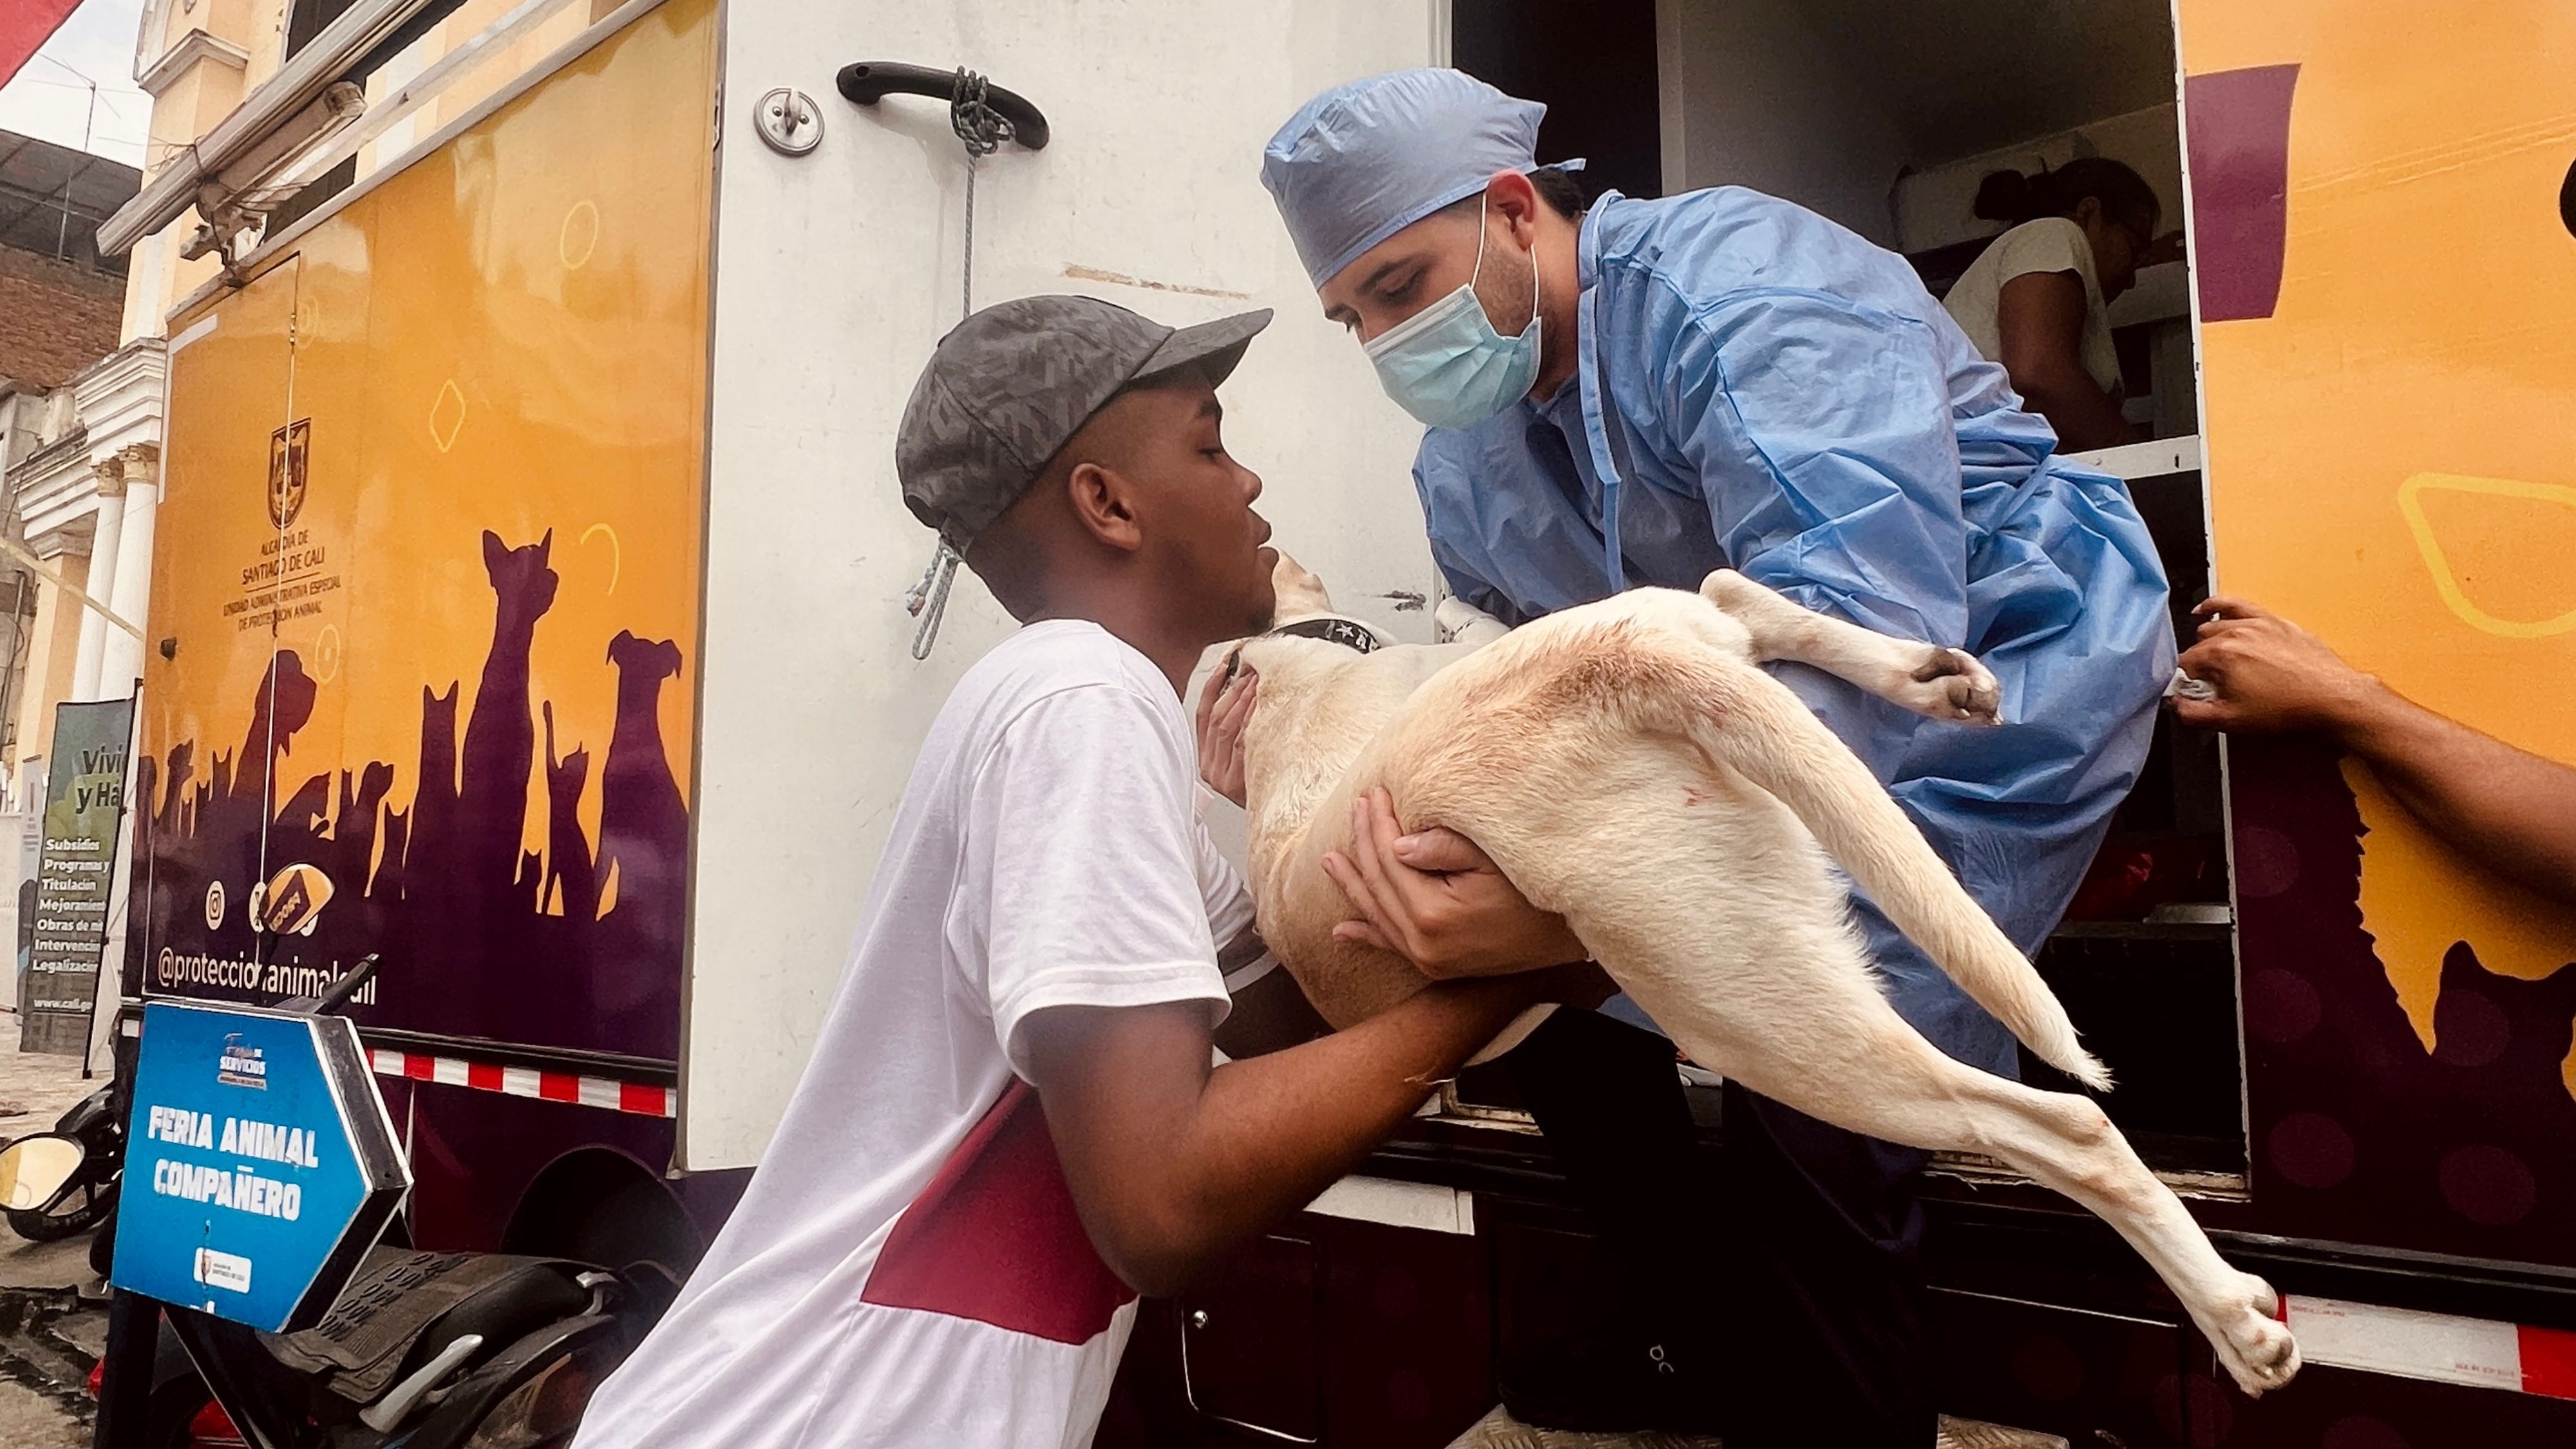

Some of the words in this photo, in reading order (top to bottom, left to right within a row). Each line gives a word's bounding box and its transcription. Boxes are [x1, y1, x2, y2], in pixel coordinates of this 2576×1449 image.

[261, 531, 295, 556] ALCADÍA
[298, 530, 308, 545] DE
[242, 558, 286, 585] SANTIAGO
[290, 554, 303, 571] DE
[305, 547, 325, 567] CALI
[76, 788, 93, 814] y
[46, 837, 101, 851] Subsidios
[44, 858, 102, 874] Programas
[102, 861, 111, 875] y
[37, 918, 74, 931] Obras
[76, 919, 90, 931] de
[147, 1105, 213, 1150] FERIA
[219, 1117, 319, 1168] ANIMAL
[153, 1159, 301, 1221] COMPAÑERO
